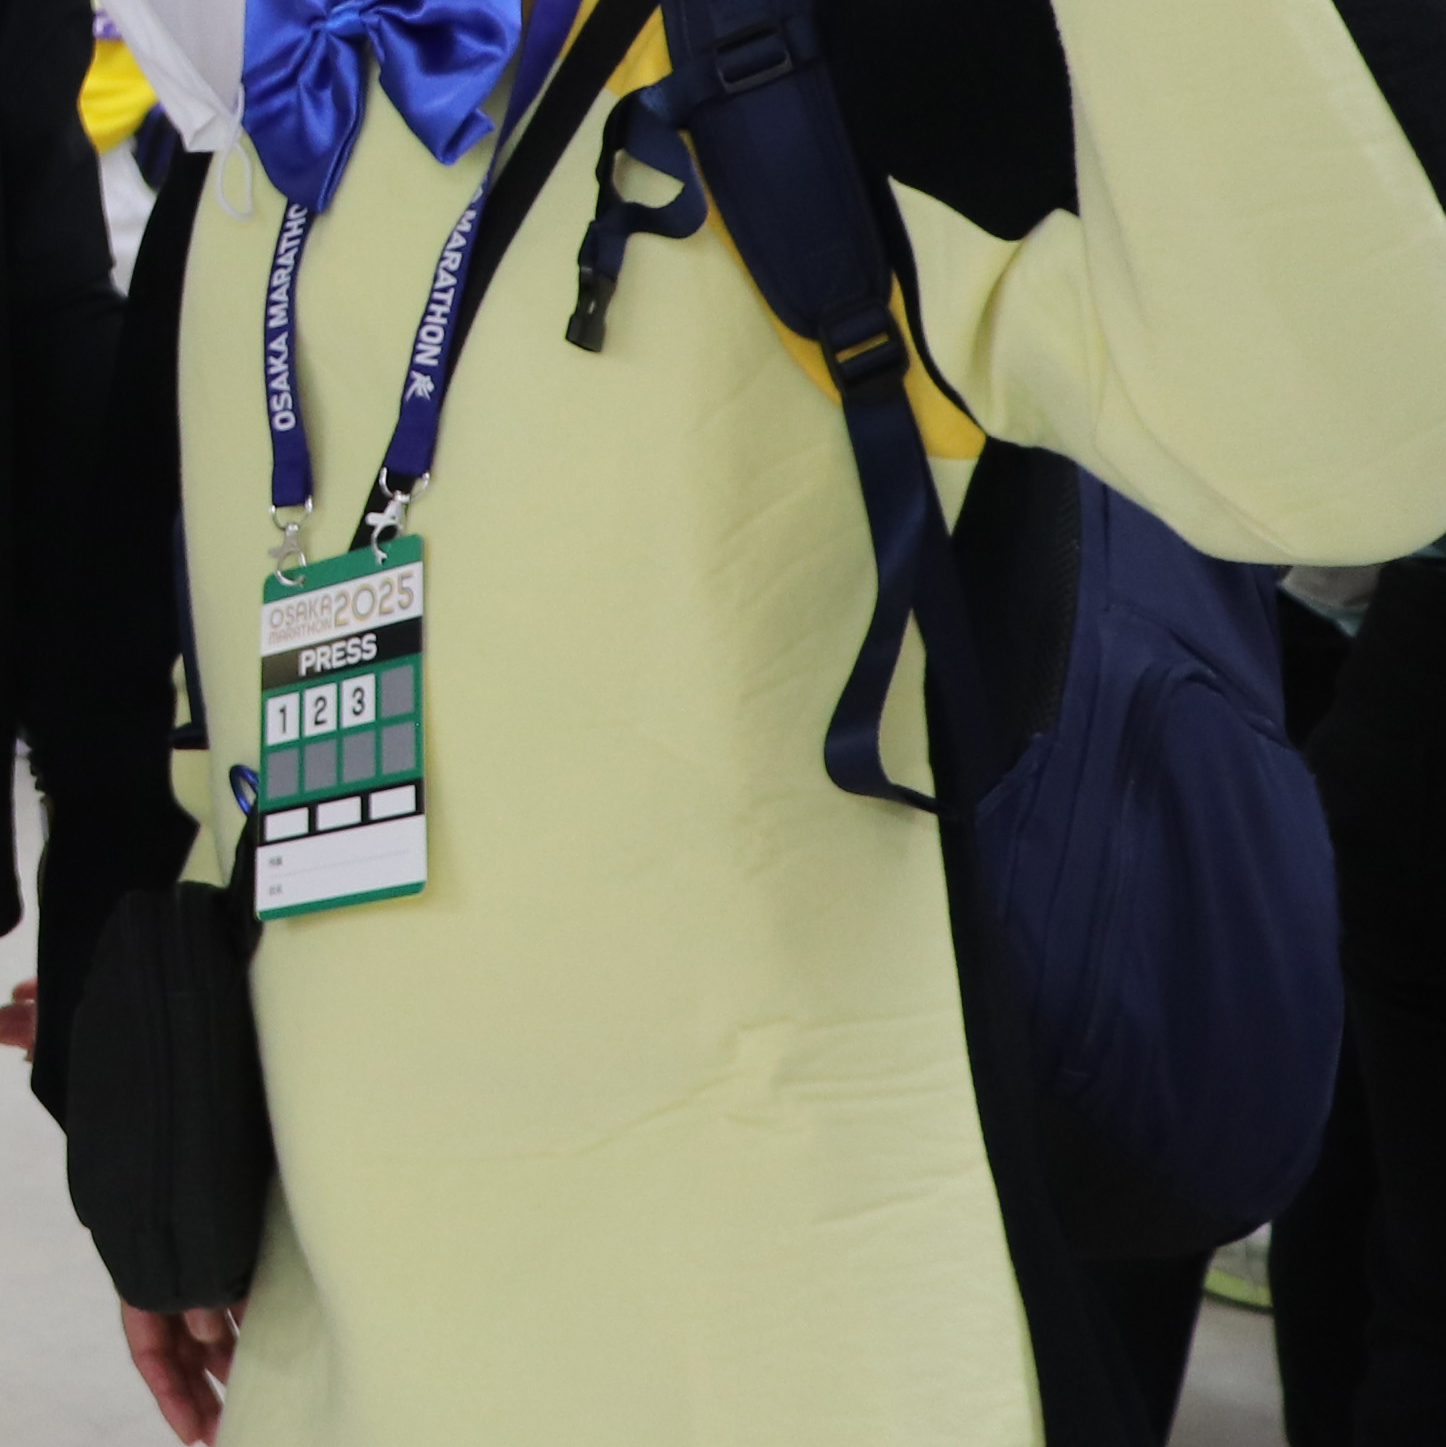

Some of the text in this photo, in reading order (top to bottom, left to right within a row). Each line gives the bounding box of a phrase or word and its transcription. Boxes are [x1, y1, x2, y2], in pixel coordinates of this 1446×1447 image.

[416, 209, 477, 366] MARATHON
[269, 332, 296, 431] OSAKA
[270, 570, 414, 629] OSAKA 2025
[298, 632, 378, 677] PRESS
[277, 686, 366, 734] 1 2 3
